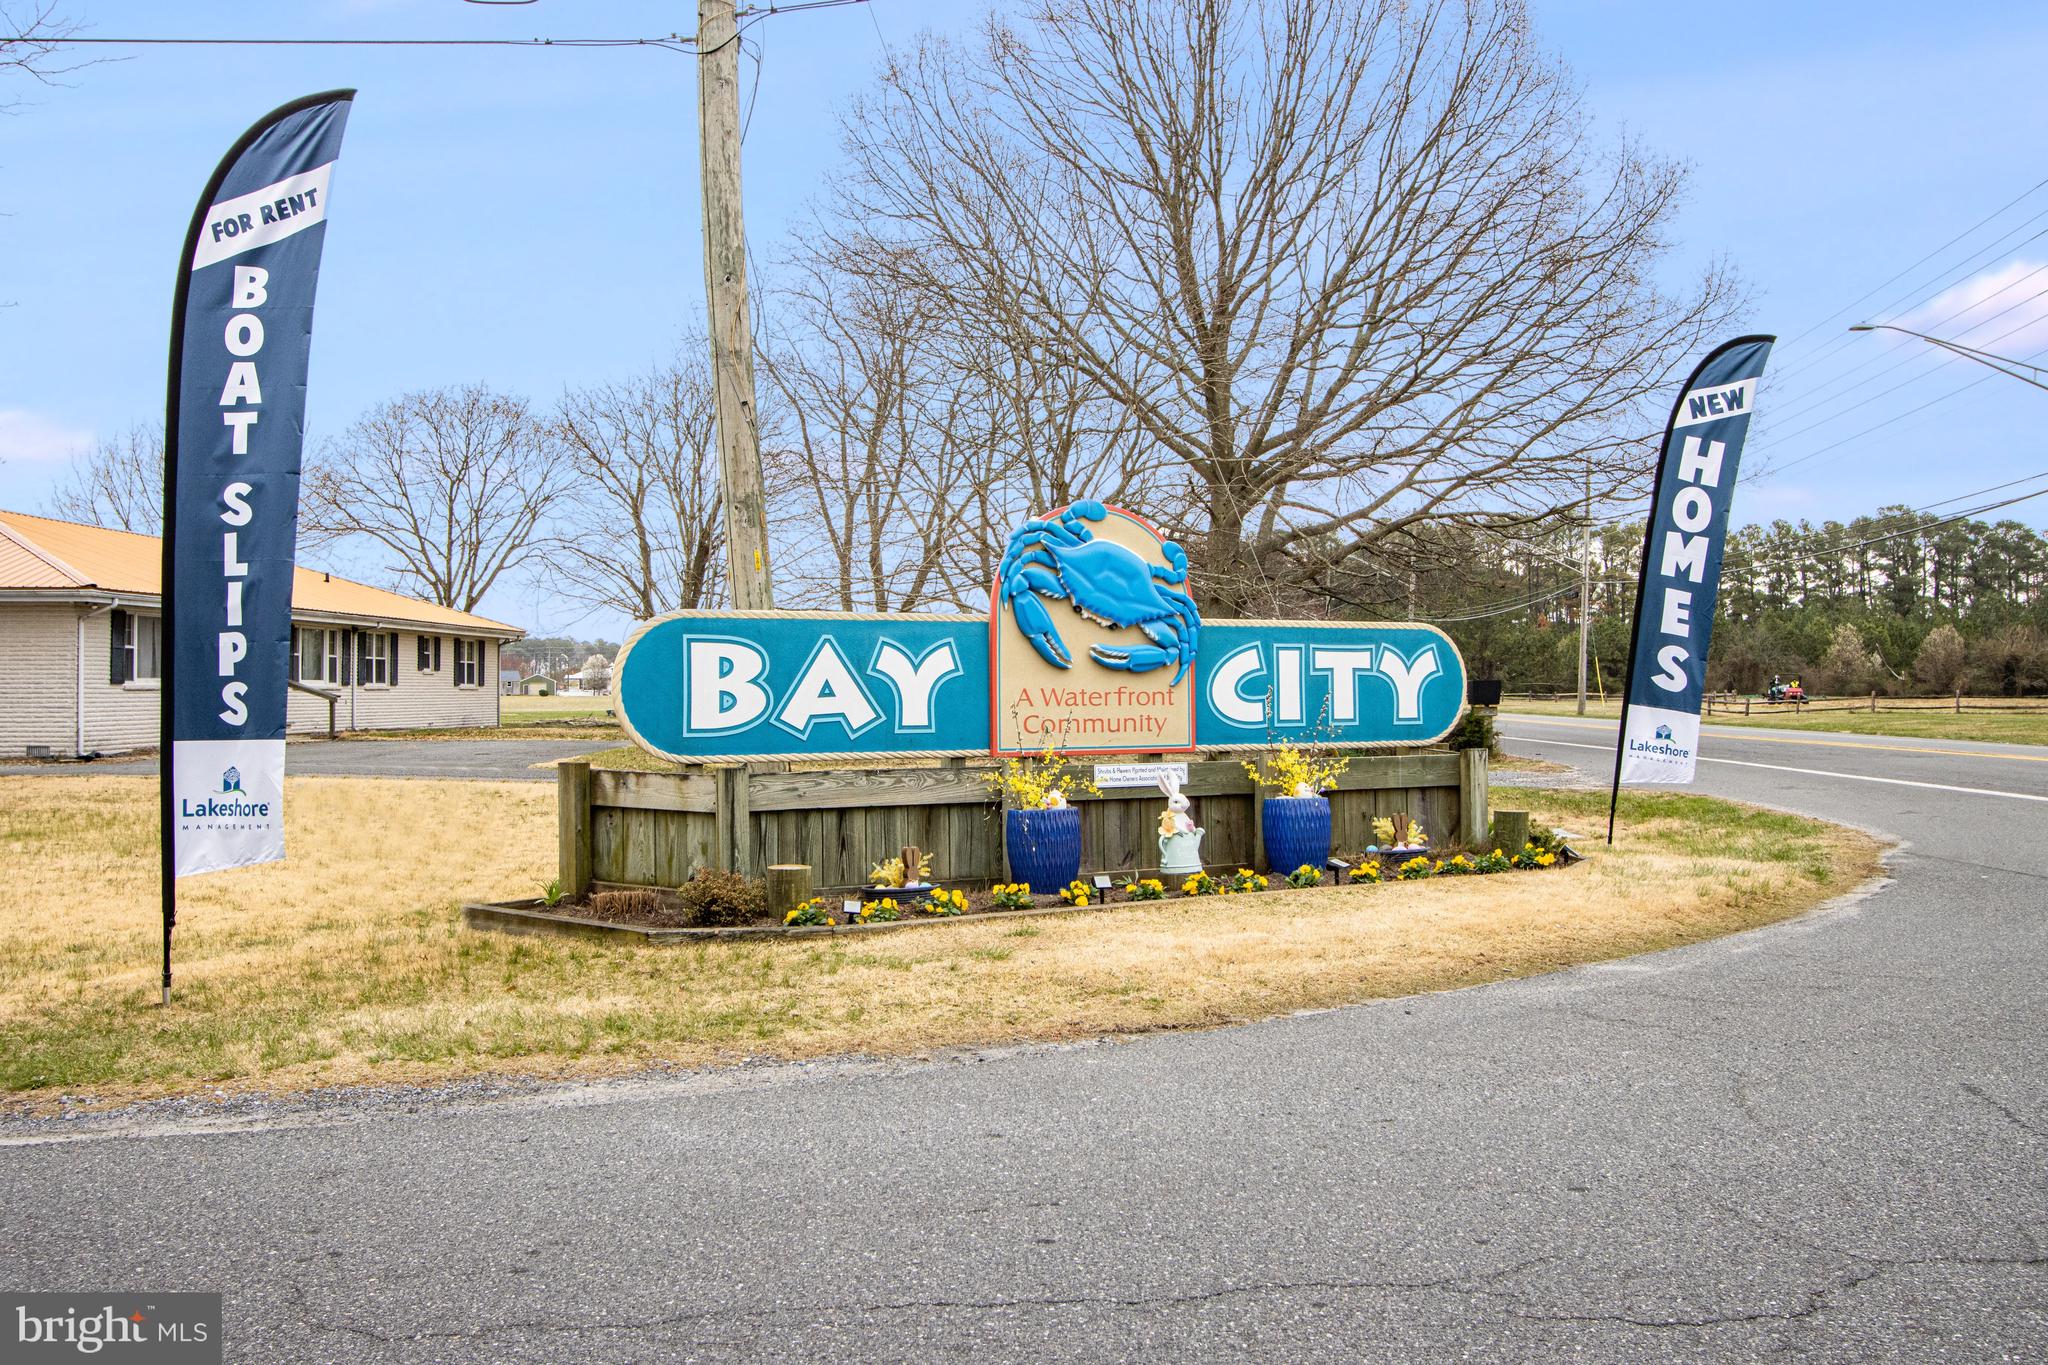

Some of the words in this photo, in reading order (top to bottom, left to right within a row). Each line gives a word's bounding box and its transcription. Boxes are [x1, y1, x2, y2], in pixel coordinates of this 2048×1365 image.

[211, 213, 254, 243] FOR
[260, 187, 318, 225] RENT
[218, 265, 270, 455] BOAT
[1688, 386, 1745, 420] NEW
[1650, 435, 1726, 693] HOMES
[218, 481, 253, 727] SLIPS
[682, 634, 964, 741] BAY
[1206, 641, 1444, 729] CITY
[1016, 688, 1034, 707] A
[1040, 686, 1175, 707] Waterfront
[1023, 714, 1168, 737] Community
[1629, 738, 1690, 758] Lakeshore
[182, 798, 270, 817] Lakeshore
